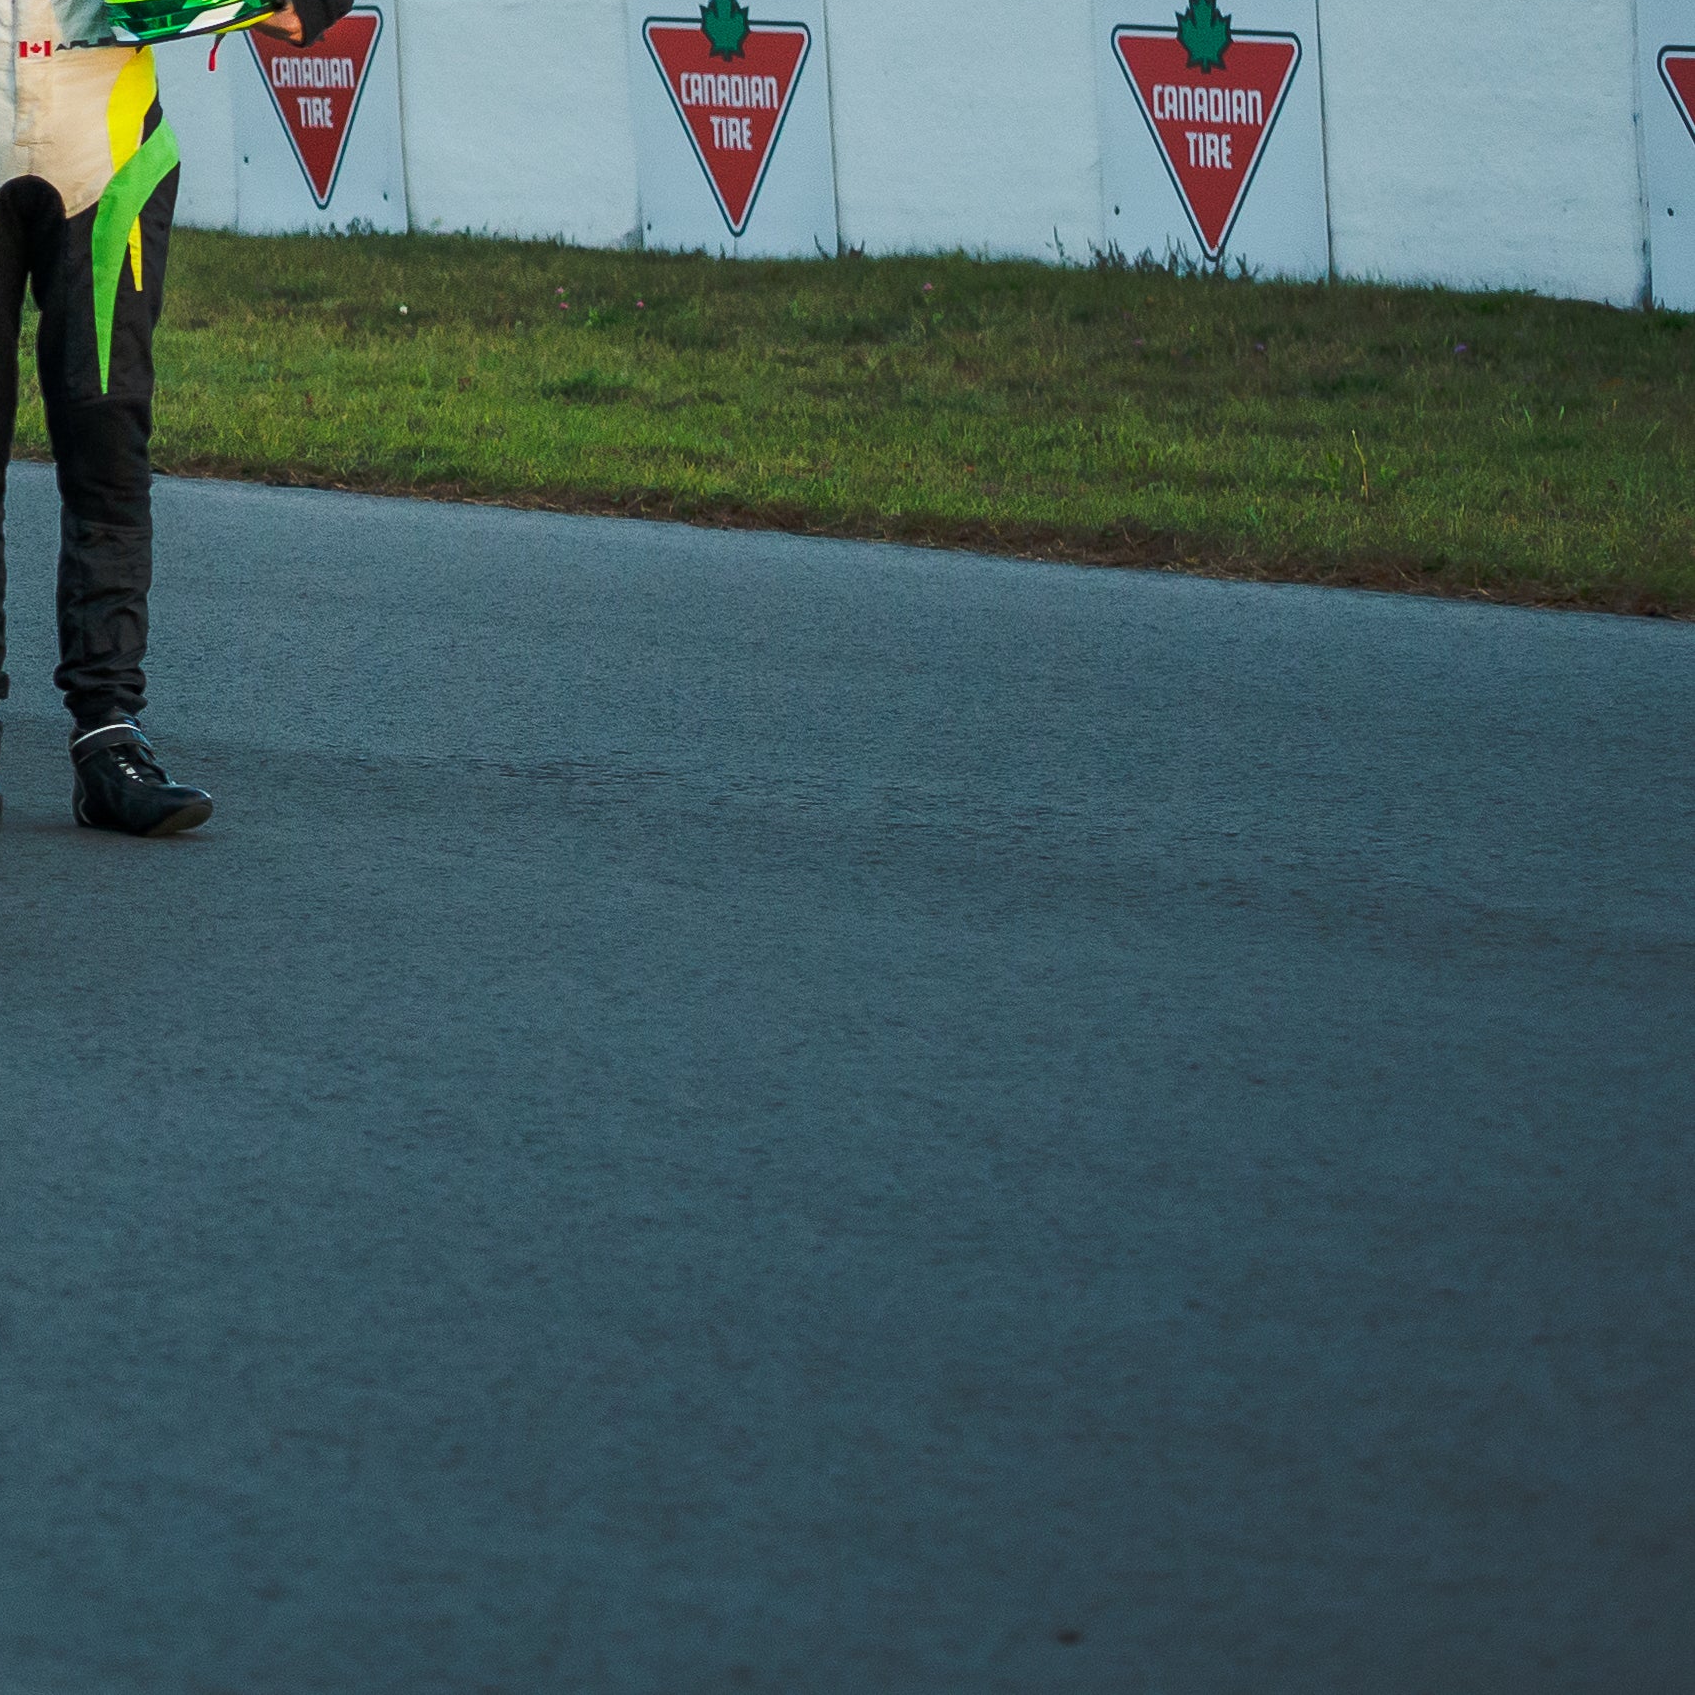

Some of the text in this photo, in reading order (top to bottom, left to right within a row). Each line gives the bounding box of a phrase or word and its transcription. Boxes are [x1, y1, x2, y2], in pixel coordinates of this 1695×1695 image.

[271, 56, 355, 89] CANADIAN
[680, 71, 779, 111] CANADIAN
[296, 97, 334, 129] TIRE
[1152, 84, 1263, 127] CANADIAN
[709, 115, 753, 151] TIRE
[1184, 131, 1233, 170] TIRE
